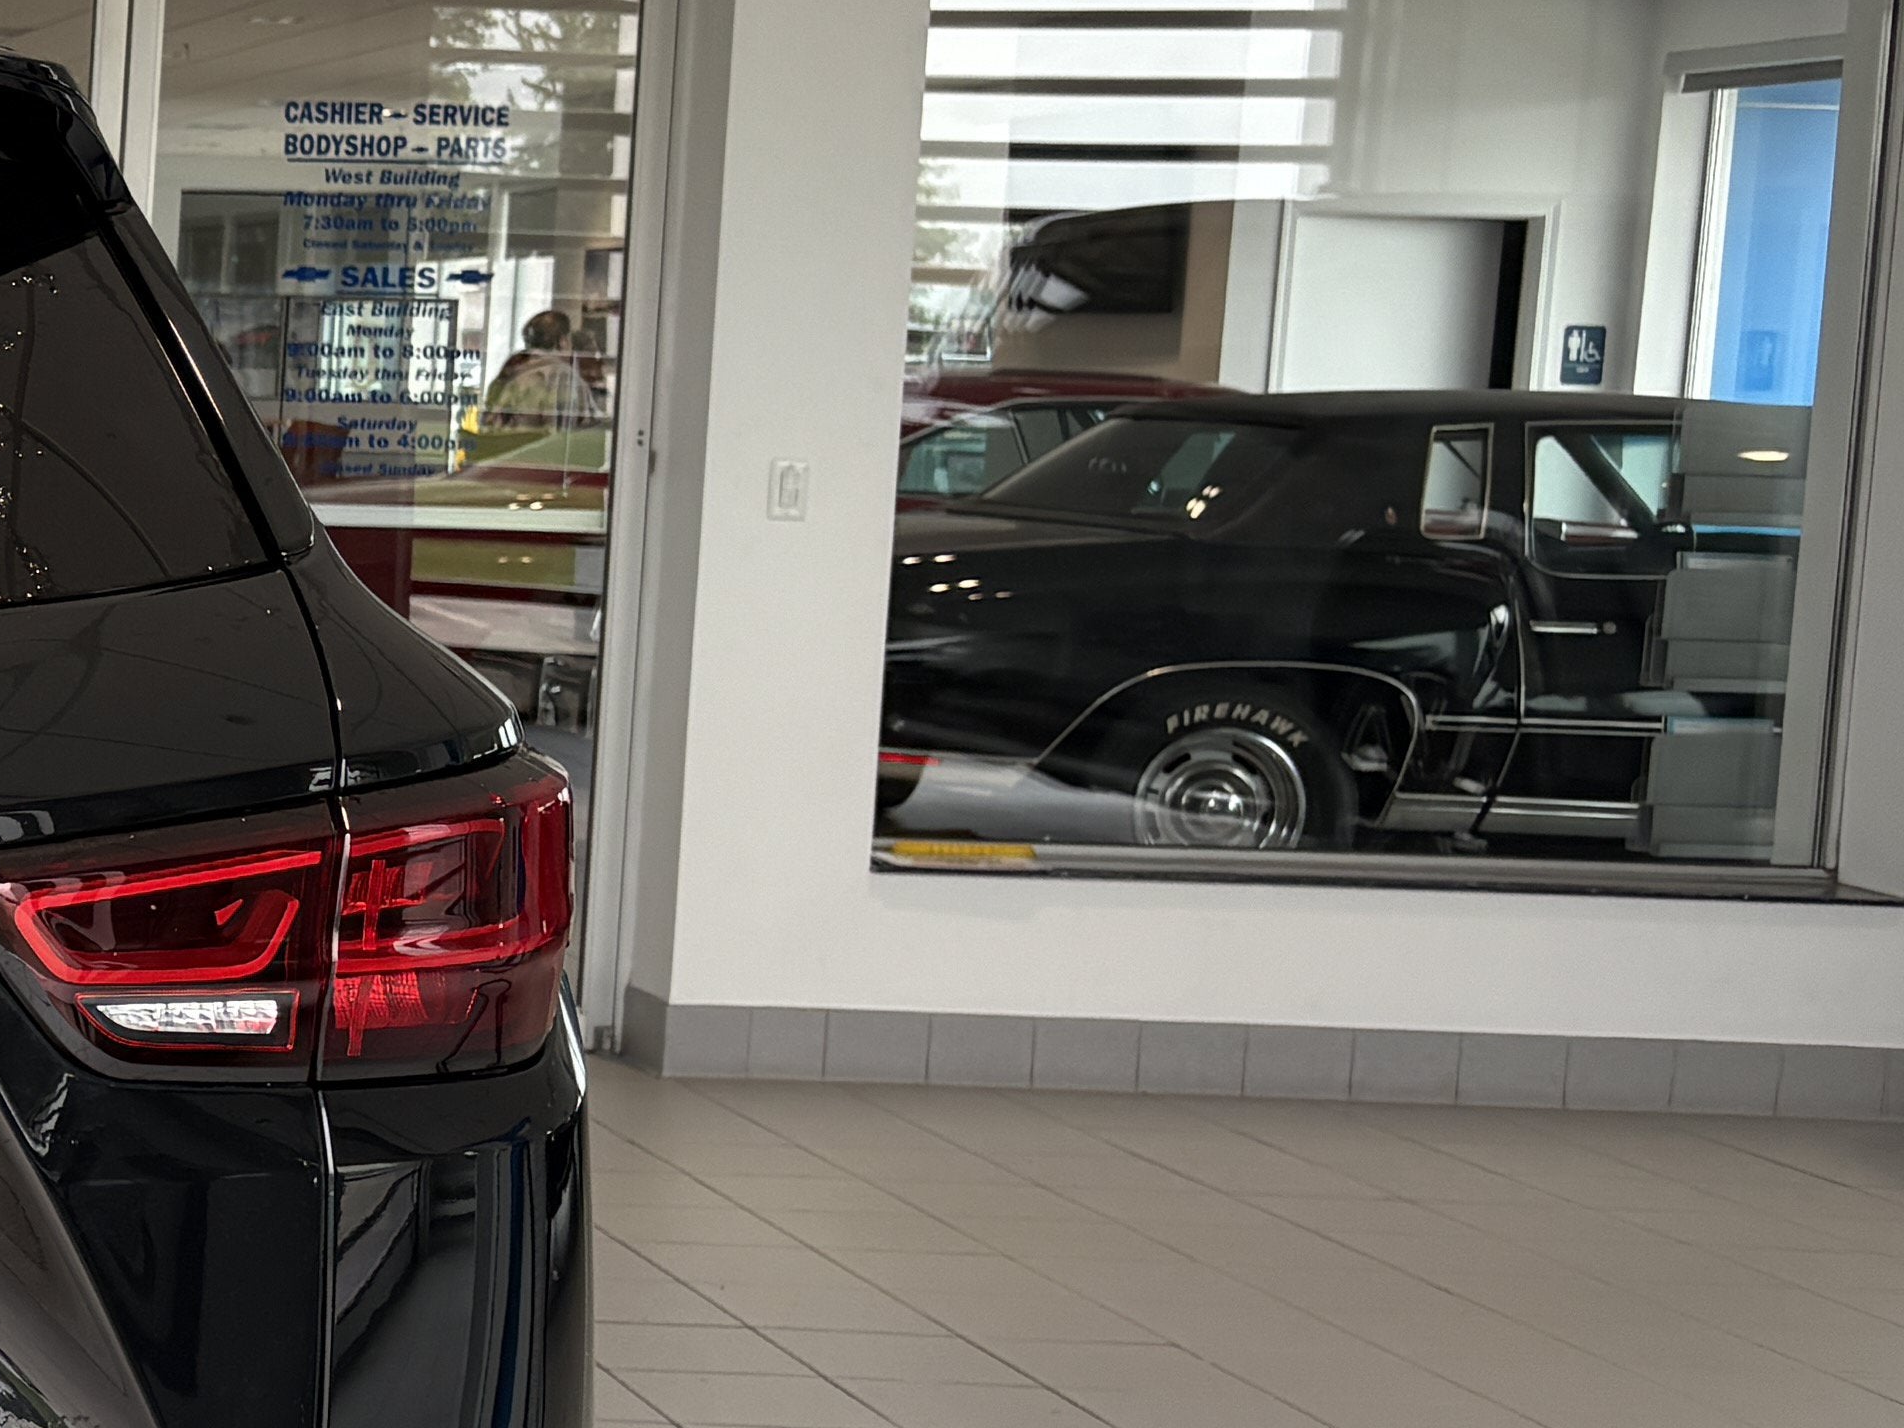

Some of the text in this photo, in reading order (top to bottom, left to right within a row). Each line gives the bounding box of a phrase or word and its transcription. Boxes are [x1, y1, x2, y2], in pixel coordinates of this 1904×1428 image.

[284, 101, 510, 127] CASHIER SERVICE
[284, 133, 507, 159] BODYSHOP PARTS
[324, 168, 461, 190] West Building
[283, 192, 368, 211] Monday
[374, 192, 418, 209] thru
[303, 215, 374, 232] 7:30am
[381, 215, 399, 232] to
[341, 265, 436, 289] SALES
[371, 302, 451, 320] Building
[347, 323, 414, 339] Monday
[374, 344, 395, 359] to
[284, 388, 363, 404] 9:00am
[371, 389, 391, 404] to
[337, 416, 418, 433] Saturday
[369, 433, 390, 449] to
